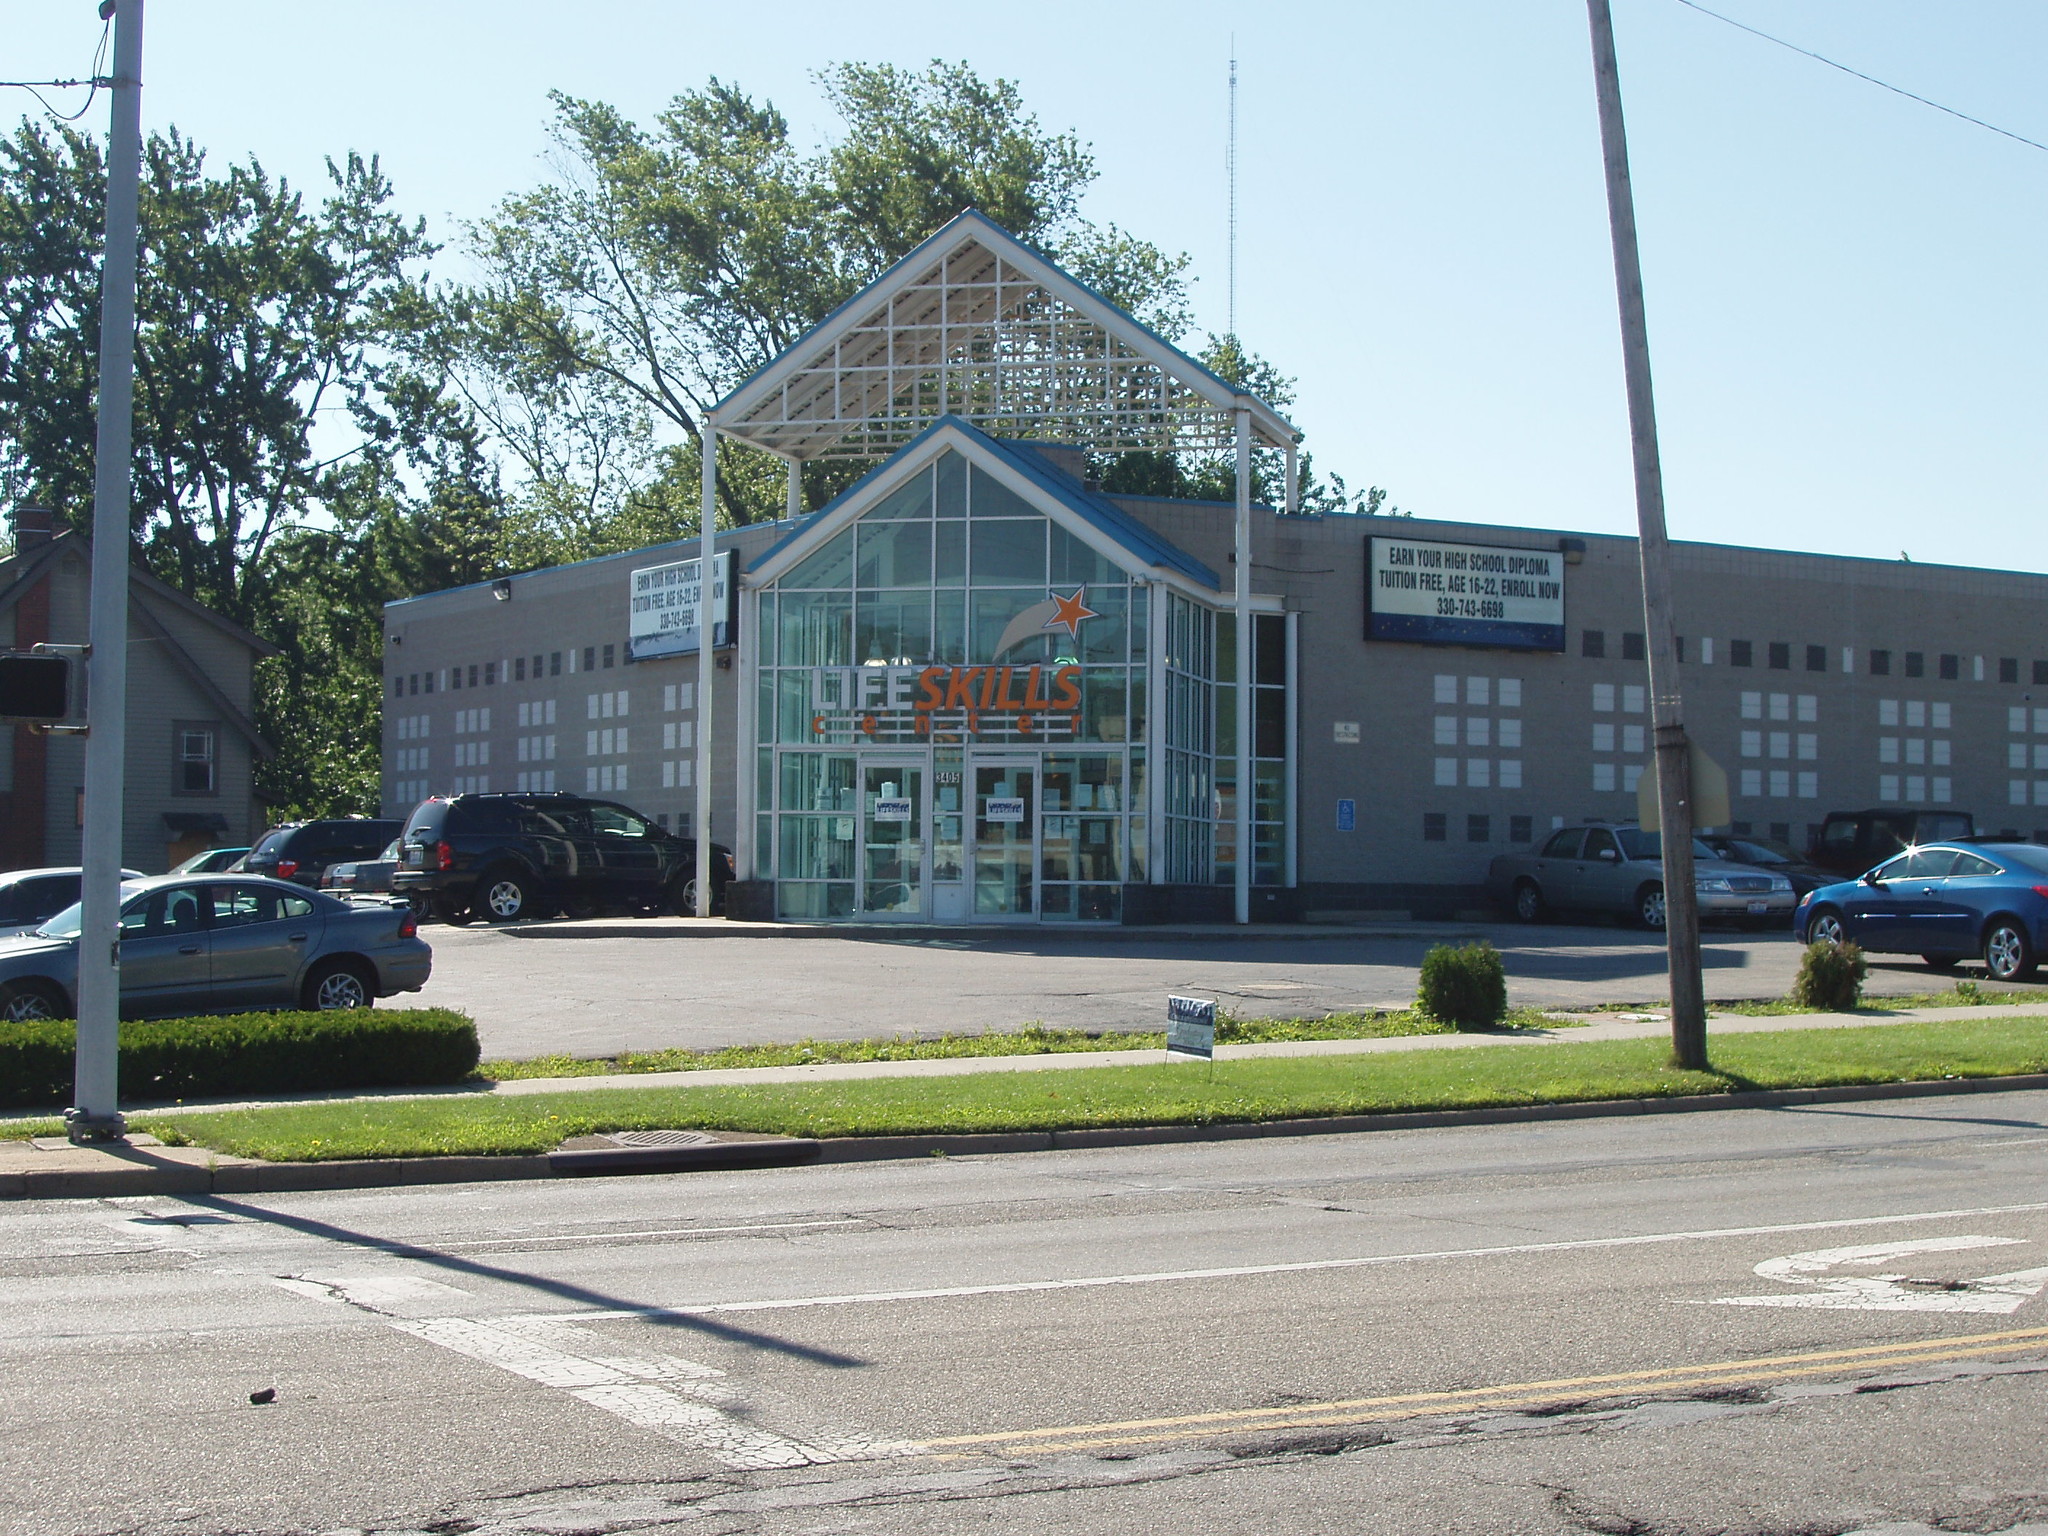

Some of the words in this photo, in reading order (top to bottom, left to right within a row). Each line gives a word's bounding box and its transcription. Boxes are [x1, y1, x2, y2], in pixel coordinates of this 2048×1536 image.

[1390, 547, 1414, 566] EARN
[1417, 550, 1442, 568] YOUR
[1444, 552, 1467, 570] HIGH
[1470, 553, 1506, 573] SCHOOL
[1509, 557, 1549, 576] DIPLOMA
[1379, 570, 1416, 589] TUITION
[1419, 573, 1445, 594] FREE,
[1448, 575, 1466, 593] AGE
[1469, 577, 1499, 598] 16-22,
[1501, 579, 1536, 598] ENROLL
[1539, 582, 1560, 600] NOW
[1437, 597, 1504, 618] 330-743-6698
[812, 712, 1082, 734] center
[936, 772, 959, 783] 3405
